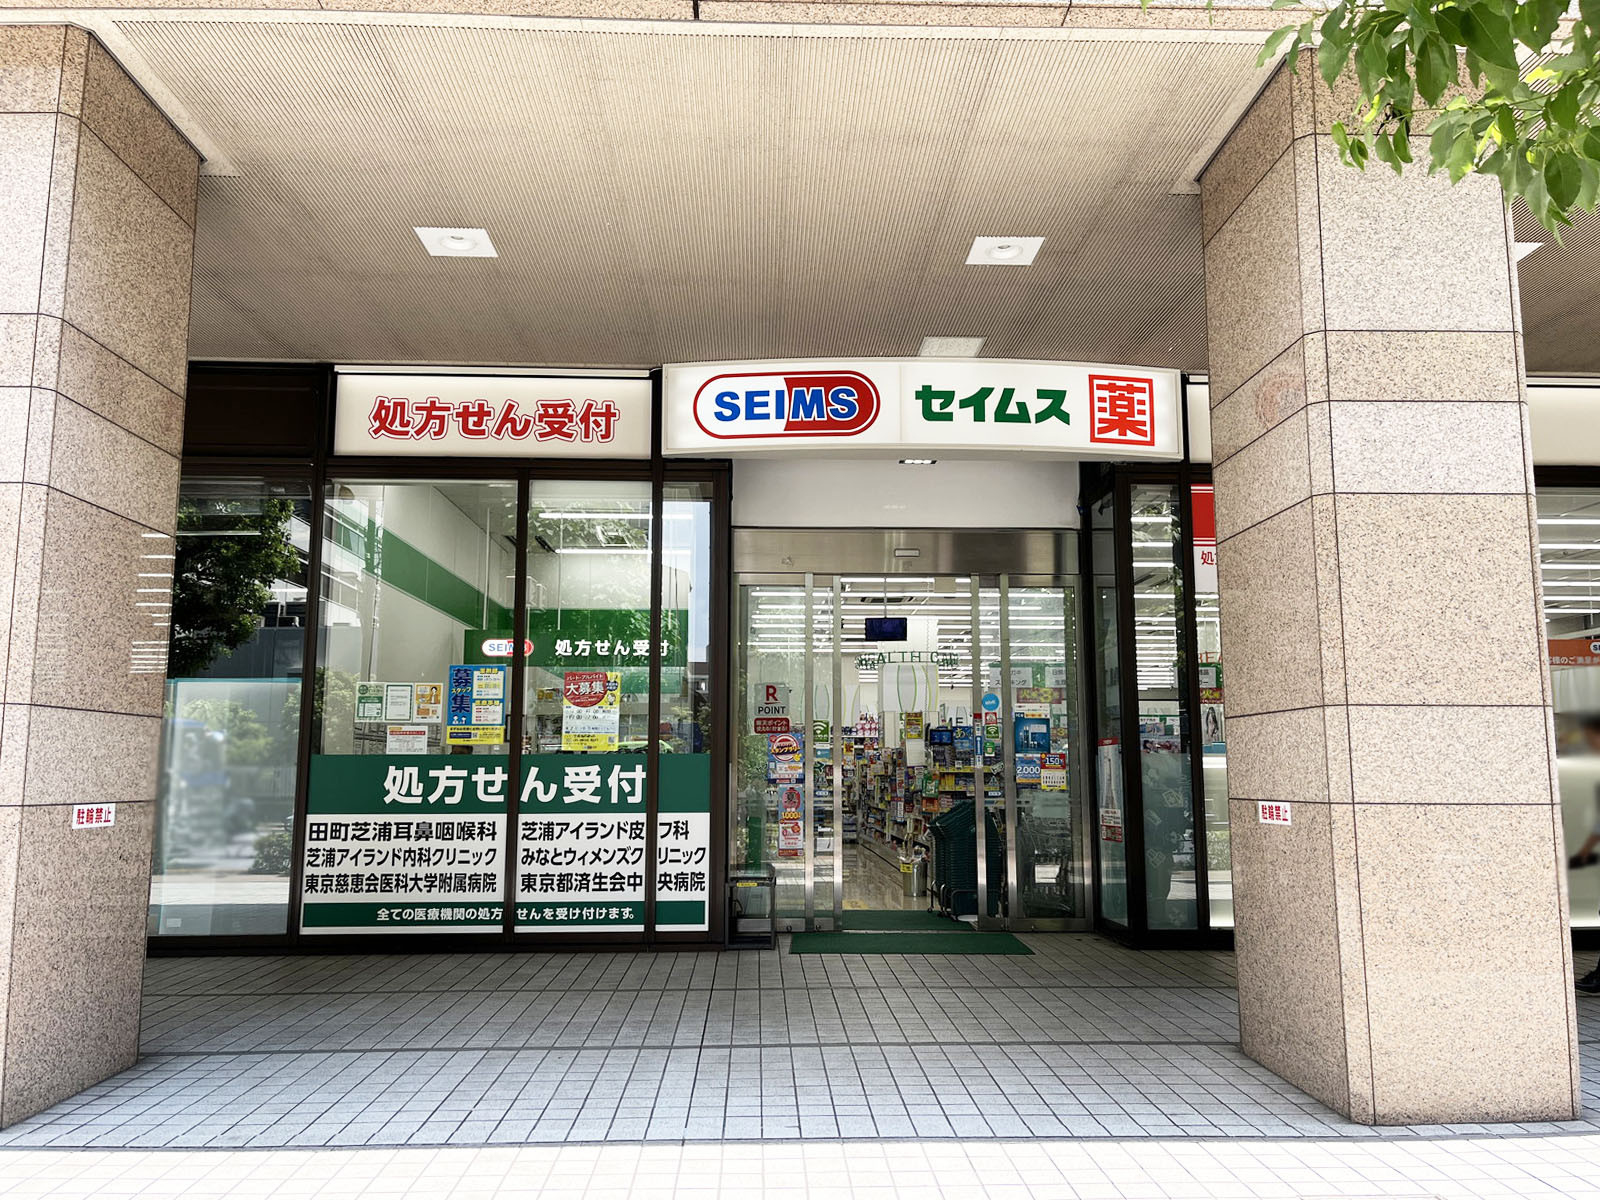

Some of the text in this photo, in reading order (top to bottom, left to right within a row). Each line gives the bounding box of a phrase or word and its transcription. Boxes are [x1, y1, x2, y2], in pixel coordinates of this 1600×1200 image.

[714, 386, 859, 422] SEIMS
[915, 384, 1071, 426] セイムス
[1095, 381, 1149, 438] 薬
[369, 396, 620, 443] 処方せん受付
[1200, 550, 1217, 566] 処
[565, 681, 605, 696] 大募集
[766, 685, 779, 702] R
[758, 706, 786, 714] POINT
[383, 764, 647, 804] 処方せん受付
[308, 821, 498, 842] 田町芝浦耳鼻咽喉科
[306, 847, 497, 868] 芝浦アイランド内科クリニック
[304, 873, 497, 894] 東京慈恵会医科大学附属病院
